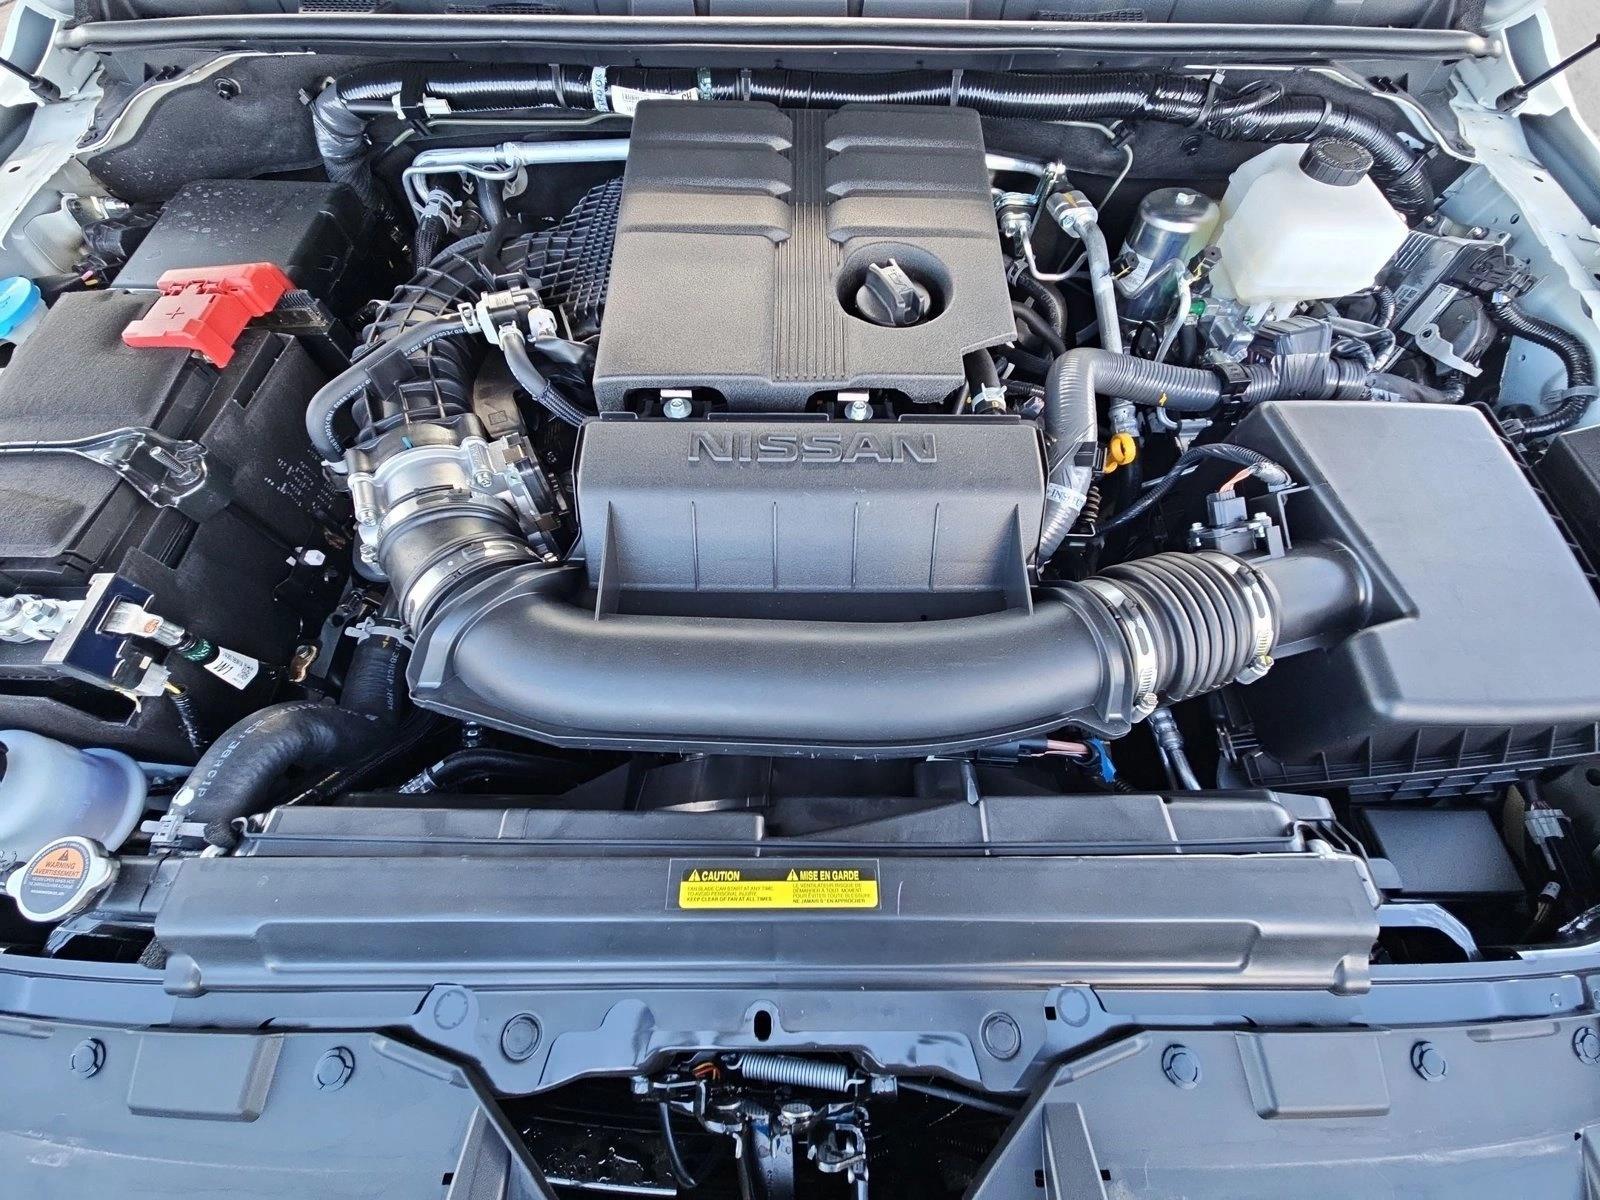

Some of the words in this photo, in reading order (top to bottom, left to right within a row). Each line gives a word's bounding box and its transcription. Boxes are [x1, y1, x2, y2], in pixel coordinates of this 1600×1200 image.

[687, 432, 938, 464] NISSAN
[45, 861, 76, 870] WARNING
[34, 868, 80, 877] AVERTISSEMENT
[701, 870, 740, 881] CAUTION
[800, 870, 819, 881] MISE
[820, 870, 831, 881] EN
[832, 870, 859, 881] GARDE
